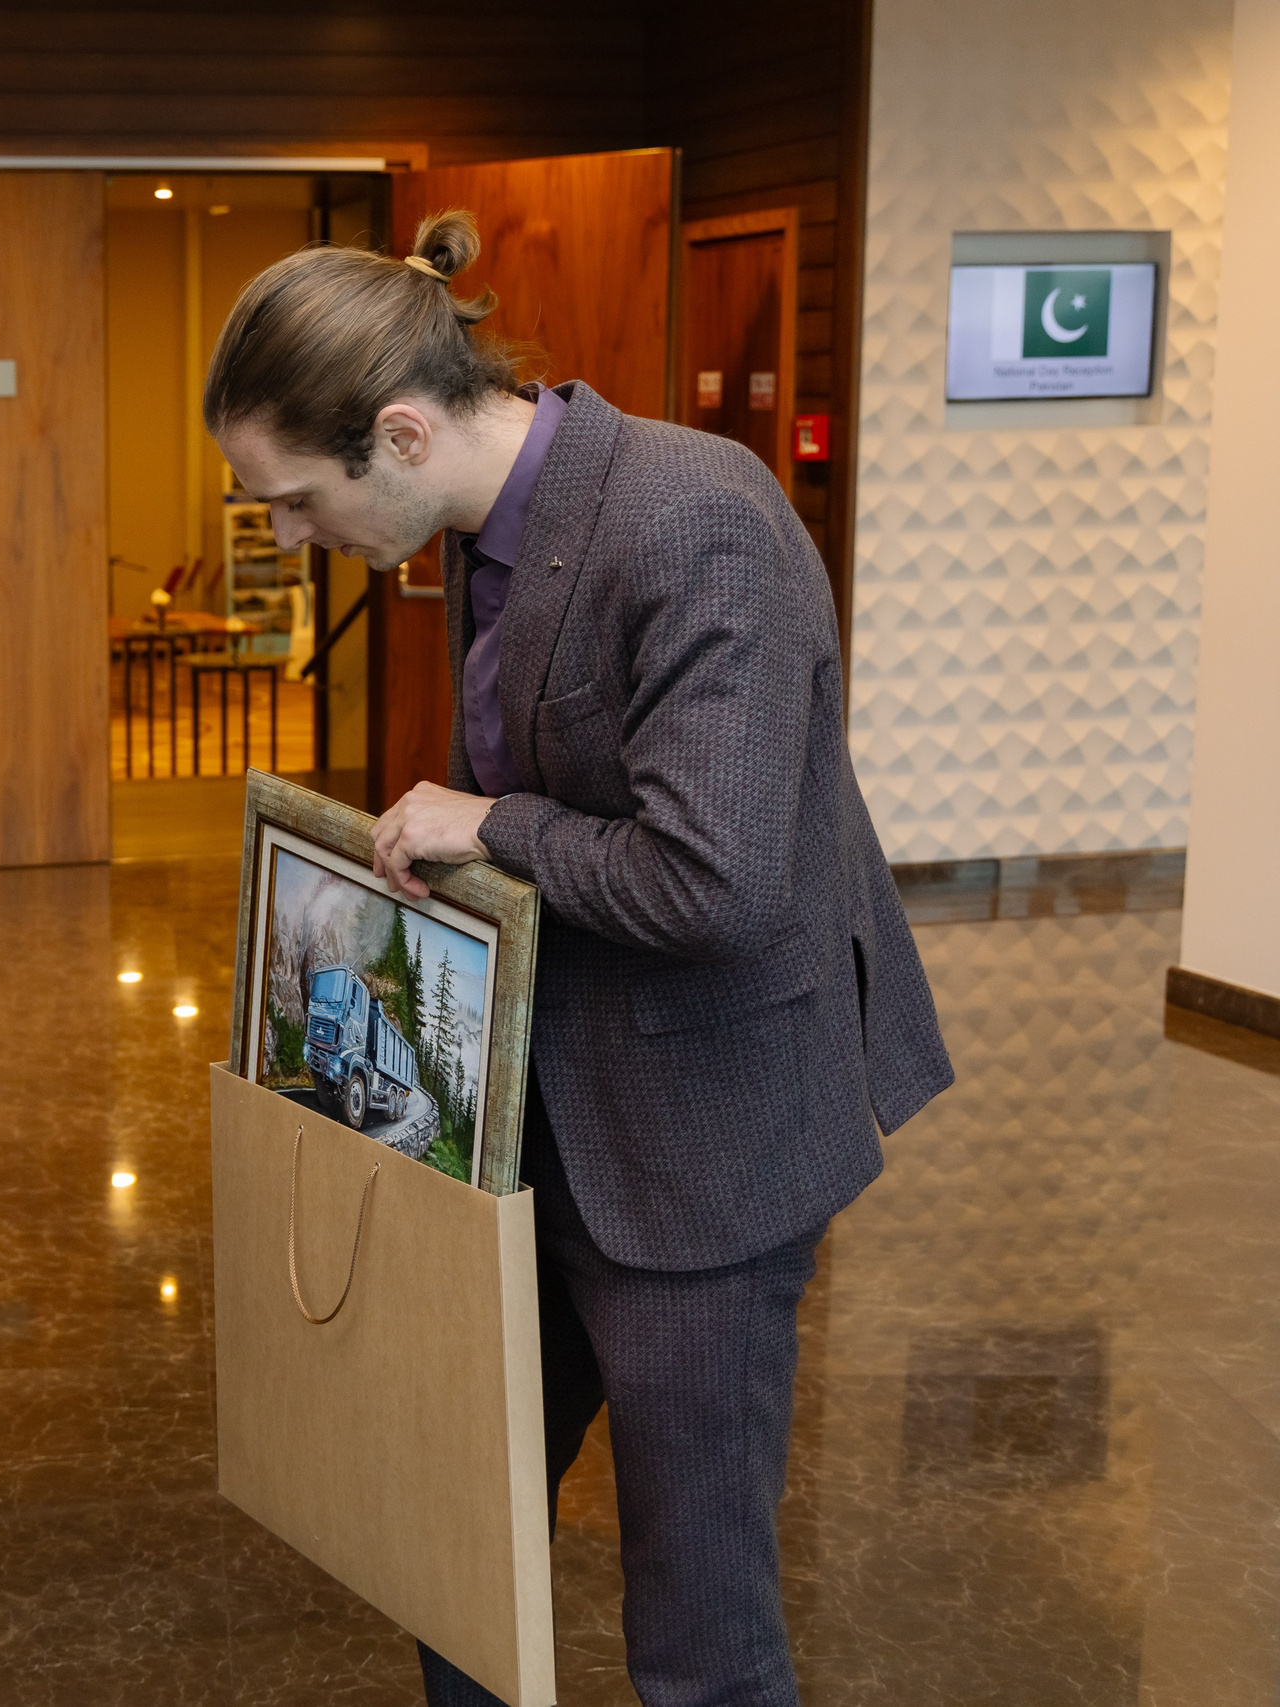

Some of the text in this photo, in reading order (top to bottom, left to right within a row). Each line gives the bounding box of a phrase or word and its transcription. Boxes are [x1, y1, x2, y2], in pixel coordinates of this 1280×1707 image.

[994, 364, 1113, 378] National Day Reception
[1029, 380, 1073, 391] Pakistan
